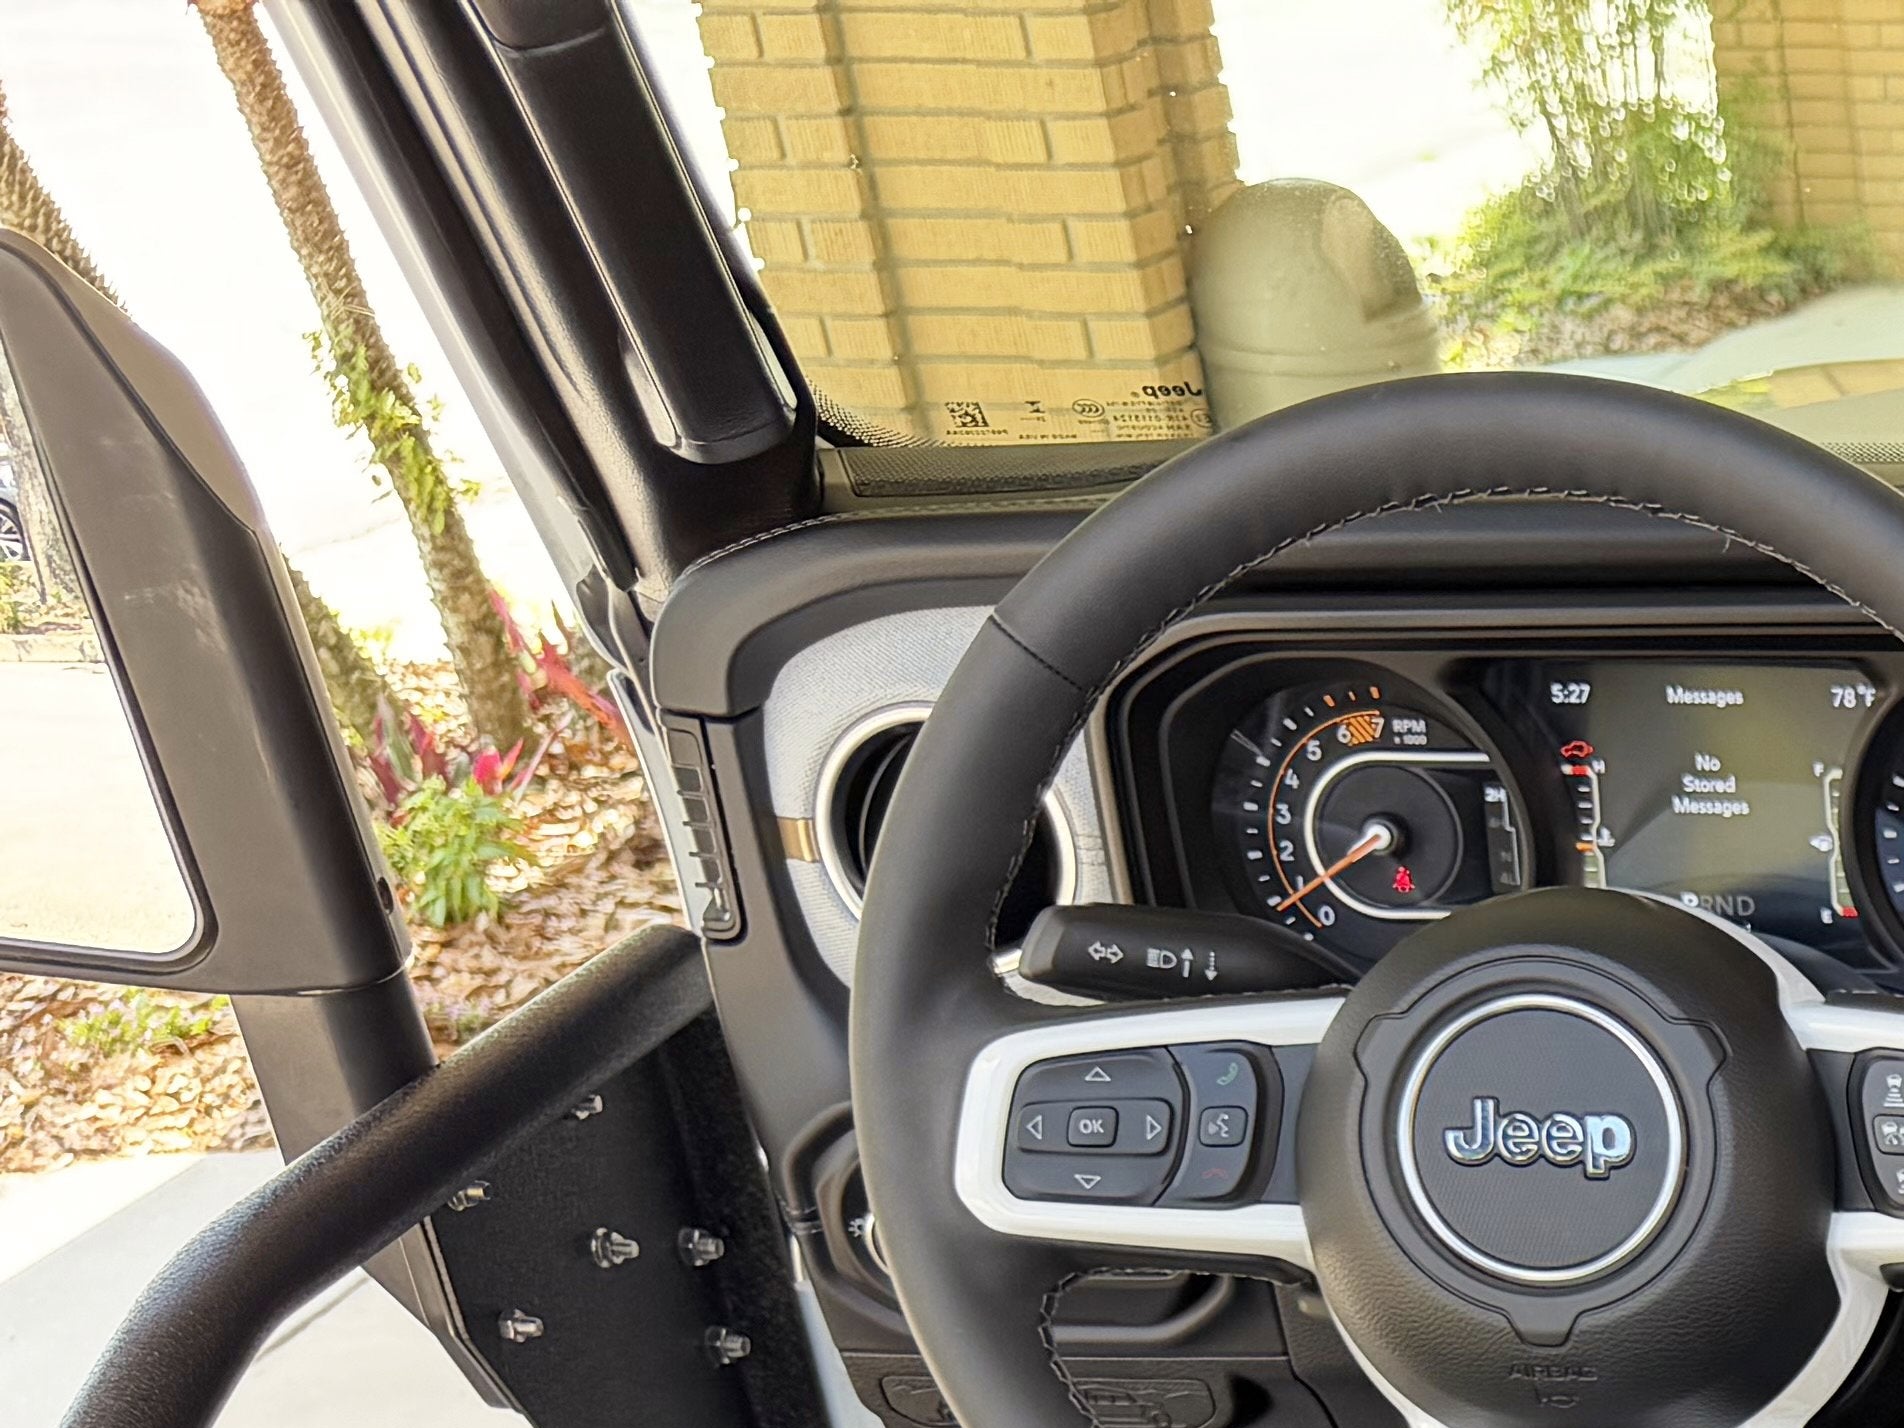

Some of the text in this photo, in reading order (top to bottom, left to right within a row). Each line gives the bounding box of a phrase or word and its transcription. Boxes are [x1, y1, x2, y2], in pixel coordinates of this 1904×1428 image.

[1550, 682, 1591, 705] 5:27
[1665, 685, 1744, 708] Messages
[1336, 724, 1352, 744] 6
[1371, 717, 1385, 738] 7
[1391, 719, 1427, 733] RPM
[1306, 740, 1322, 761] 5
[1402, 734, 1428, 746] 1000
[1694, 753, 1721, 772] No
[1284, 768, 1300, 789] 4
[1682, 775, 1736, 794] Stored
[1275, 803, 1292, 825] 3
[1671, 795, 1750, 817] Messages
[1279, 840, 1295, 861] 2
[1317, 905, 1336, 927] 0
[1079, 1118, 1105, 1134] OK
[1444, 1096, 1634, 1178] Jeep
